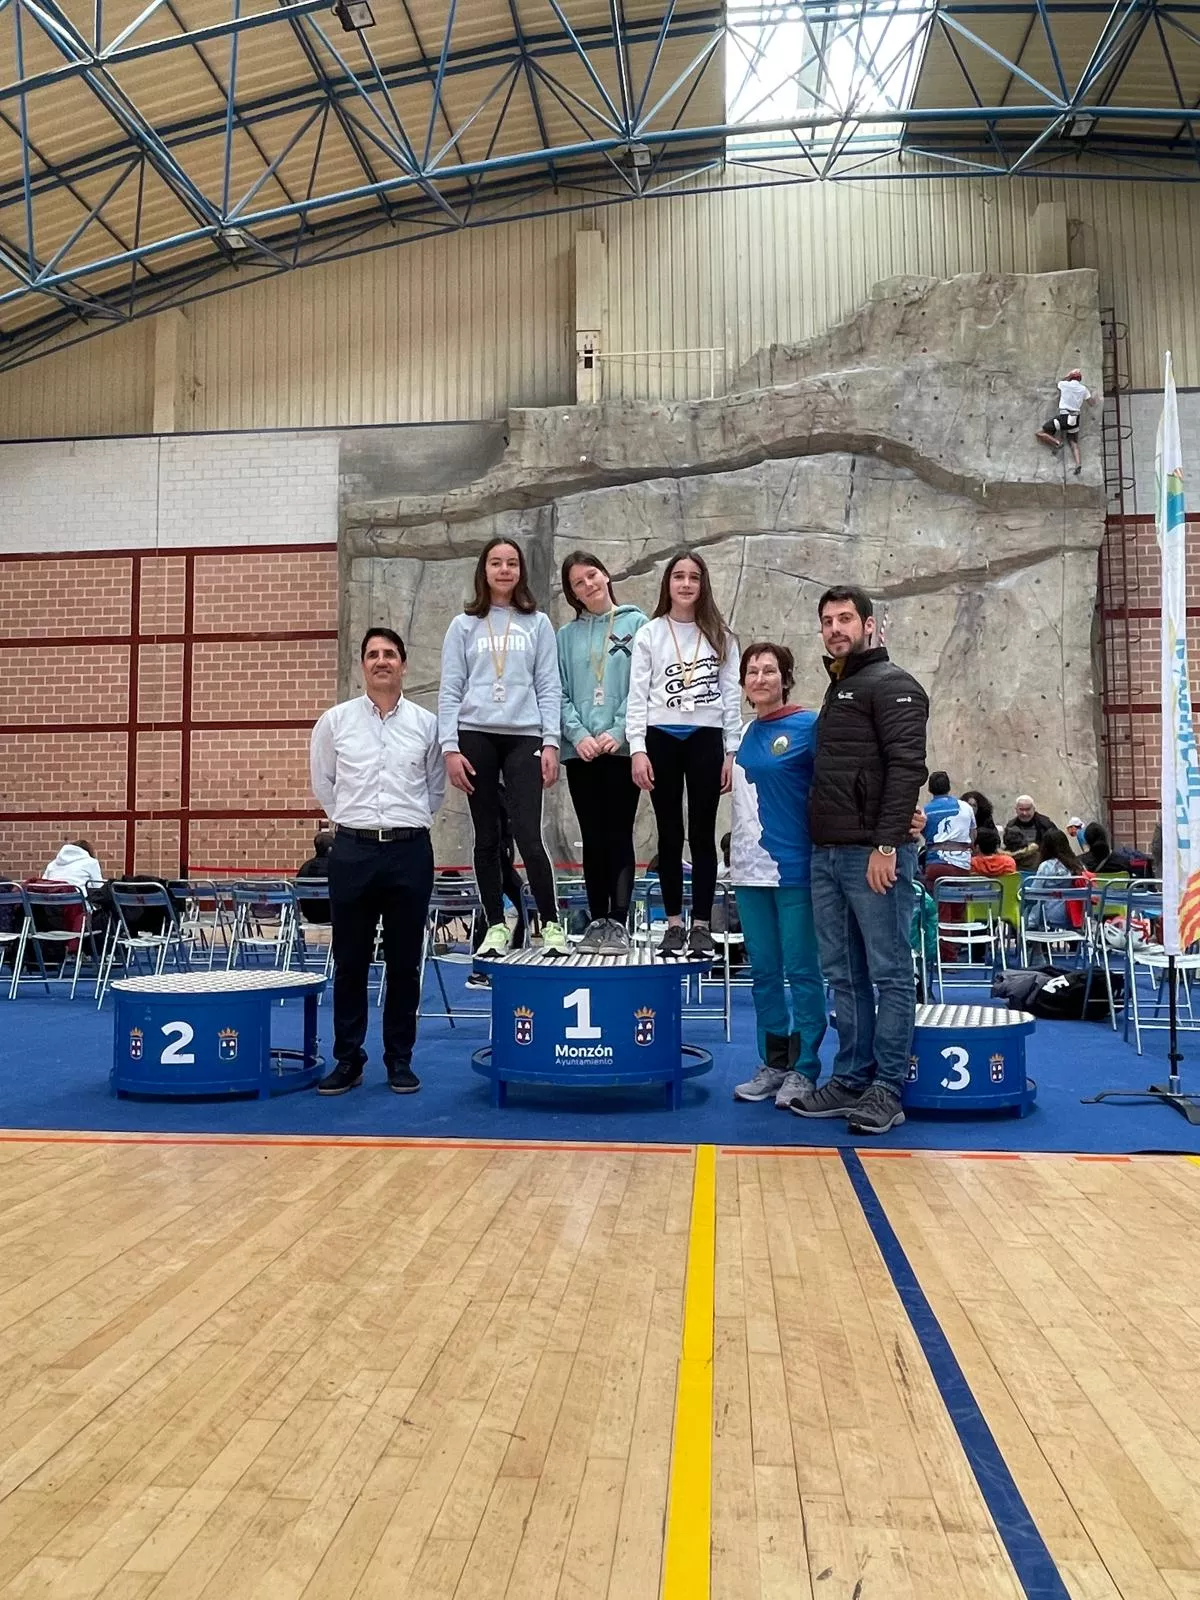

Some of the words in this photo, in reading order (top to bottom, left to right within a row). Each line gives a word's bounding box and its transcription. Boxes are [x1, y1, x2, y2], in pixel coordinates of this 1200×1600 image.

[477, 634, 526, 653] PUMA
[563, 988, 602, 1039] 1
[160, 1021, 195, 1065] 2
[555, 1043, 613, 1058] Monzón
[555, 1058, 613, 1066] Ayuntamiento
[940, 1046, 971, 1091] 3
